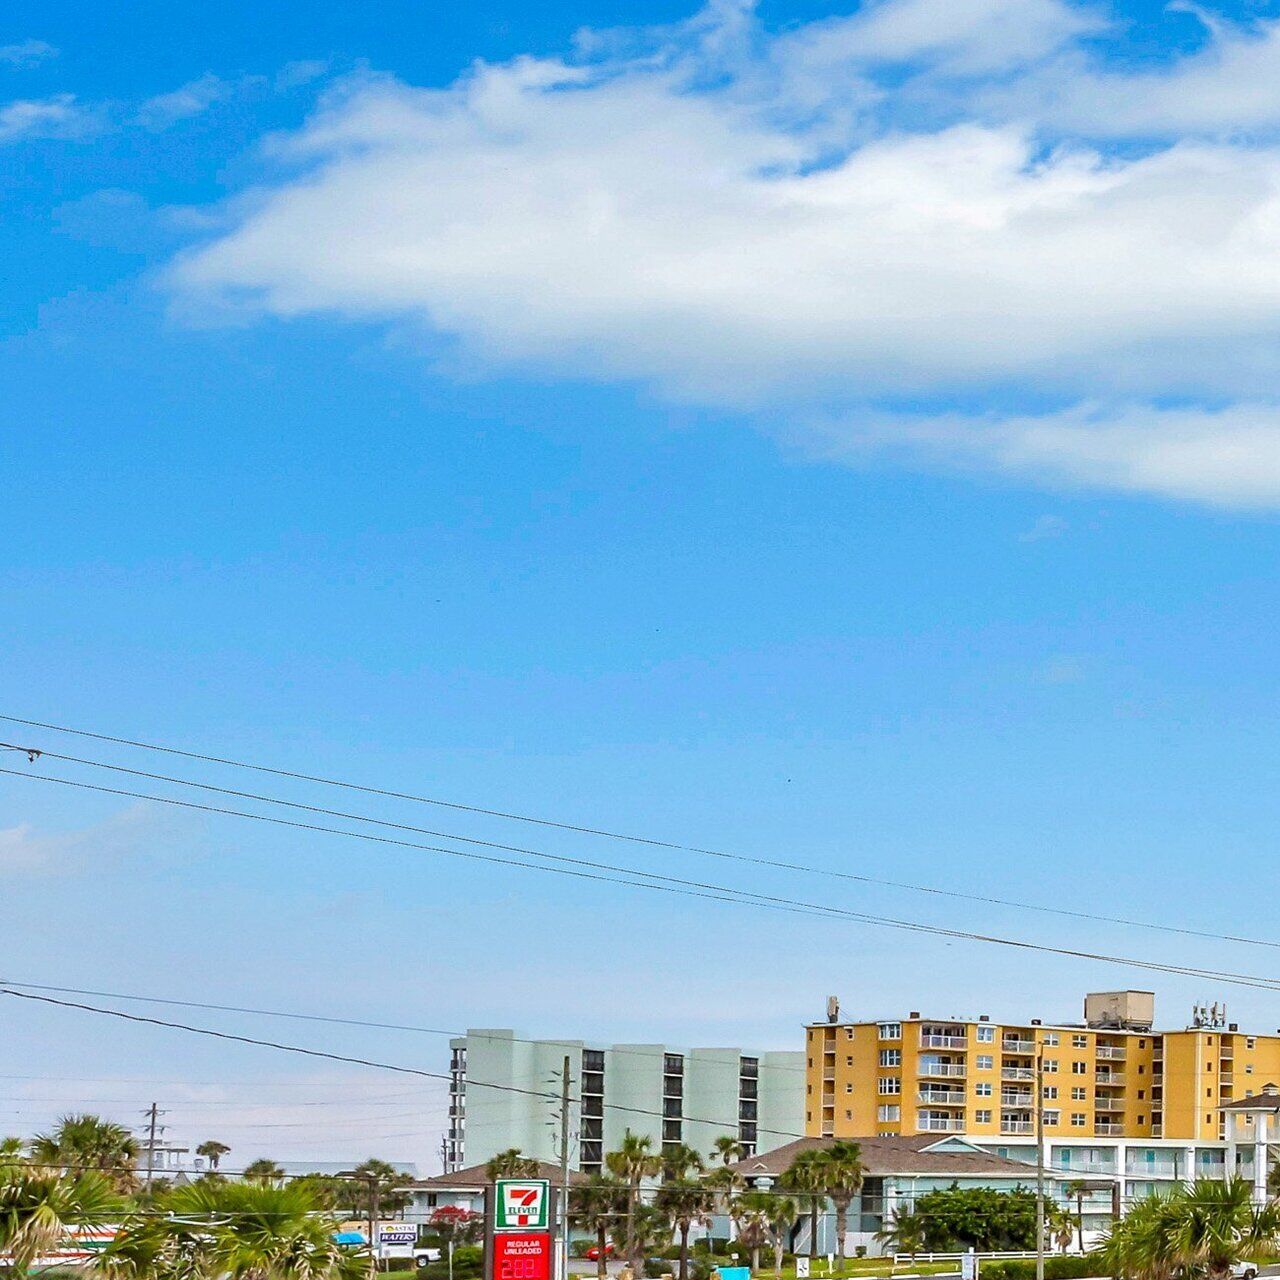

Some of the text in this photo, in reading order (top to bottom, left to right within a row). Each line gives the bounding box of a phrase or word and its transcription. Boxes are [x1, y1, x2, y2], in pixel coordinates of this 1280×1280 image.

[510, 1189, 538, 1226] 7
[506, 1240, 540, 1248] REGULAR
[503, 1247, 542, 1256] UNLEADED
